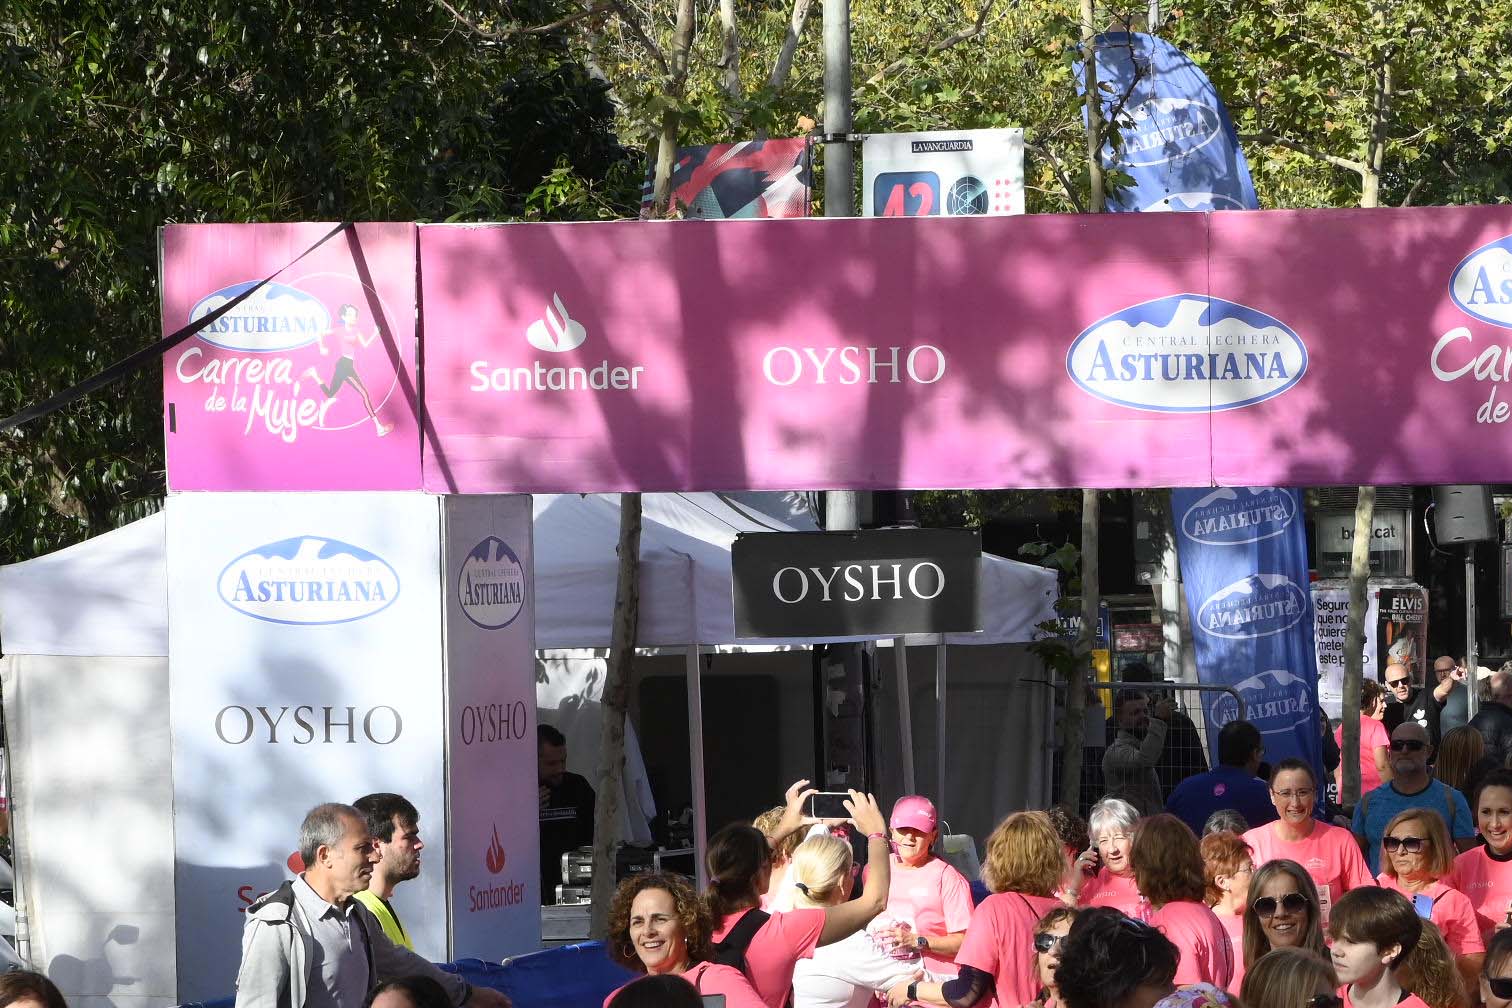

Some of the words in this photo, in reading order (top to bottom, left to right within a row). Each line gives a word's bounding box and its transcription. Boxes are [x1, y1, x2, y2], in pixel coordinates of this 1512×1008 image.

[1122, 335, 1197, 346] CENTRAL
[1206, 334, 1280, 346] LECHERA
[176, 347, 293, 385] Carrera
[470, 359, 643, 392] Santander
[762, 345, 946, 385] OYSHO
[1086, 339, 1289, 381] ASTURIANA
[205, 386, 226, 411] de
[231, 385, 247, 411] la
[244, 381, 337, 443] Mujer
[1477, 385, 1510, 424] de
[232, 569, 387, 603] ASTURIANA
[463, 570, 521, 607] ASTURIANA
[772, 561, 946, 604] OYSHO
[1318, 616, 1334, 625] que
[1392, 597, 1423, 610] ELVIS
[1320, 655, 1336, 664] este
[215, 705, 403, 745] OYSHO
[461, 701, 526, 746] OYSHO
[469, 881, 524, 913] Santander
